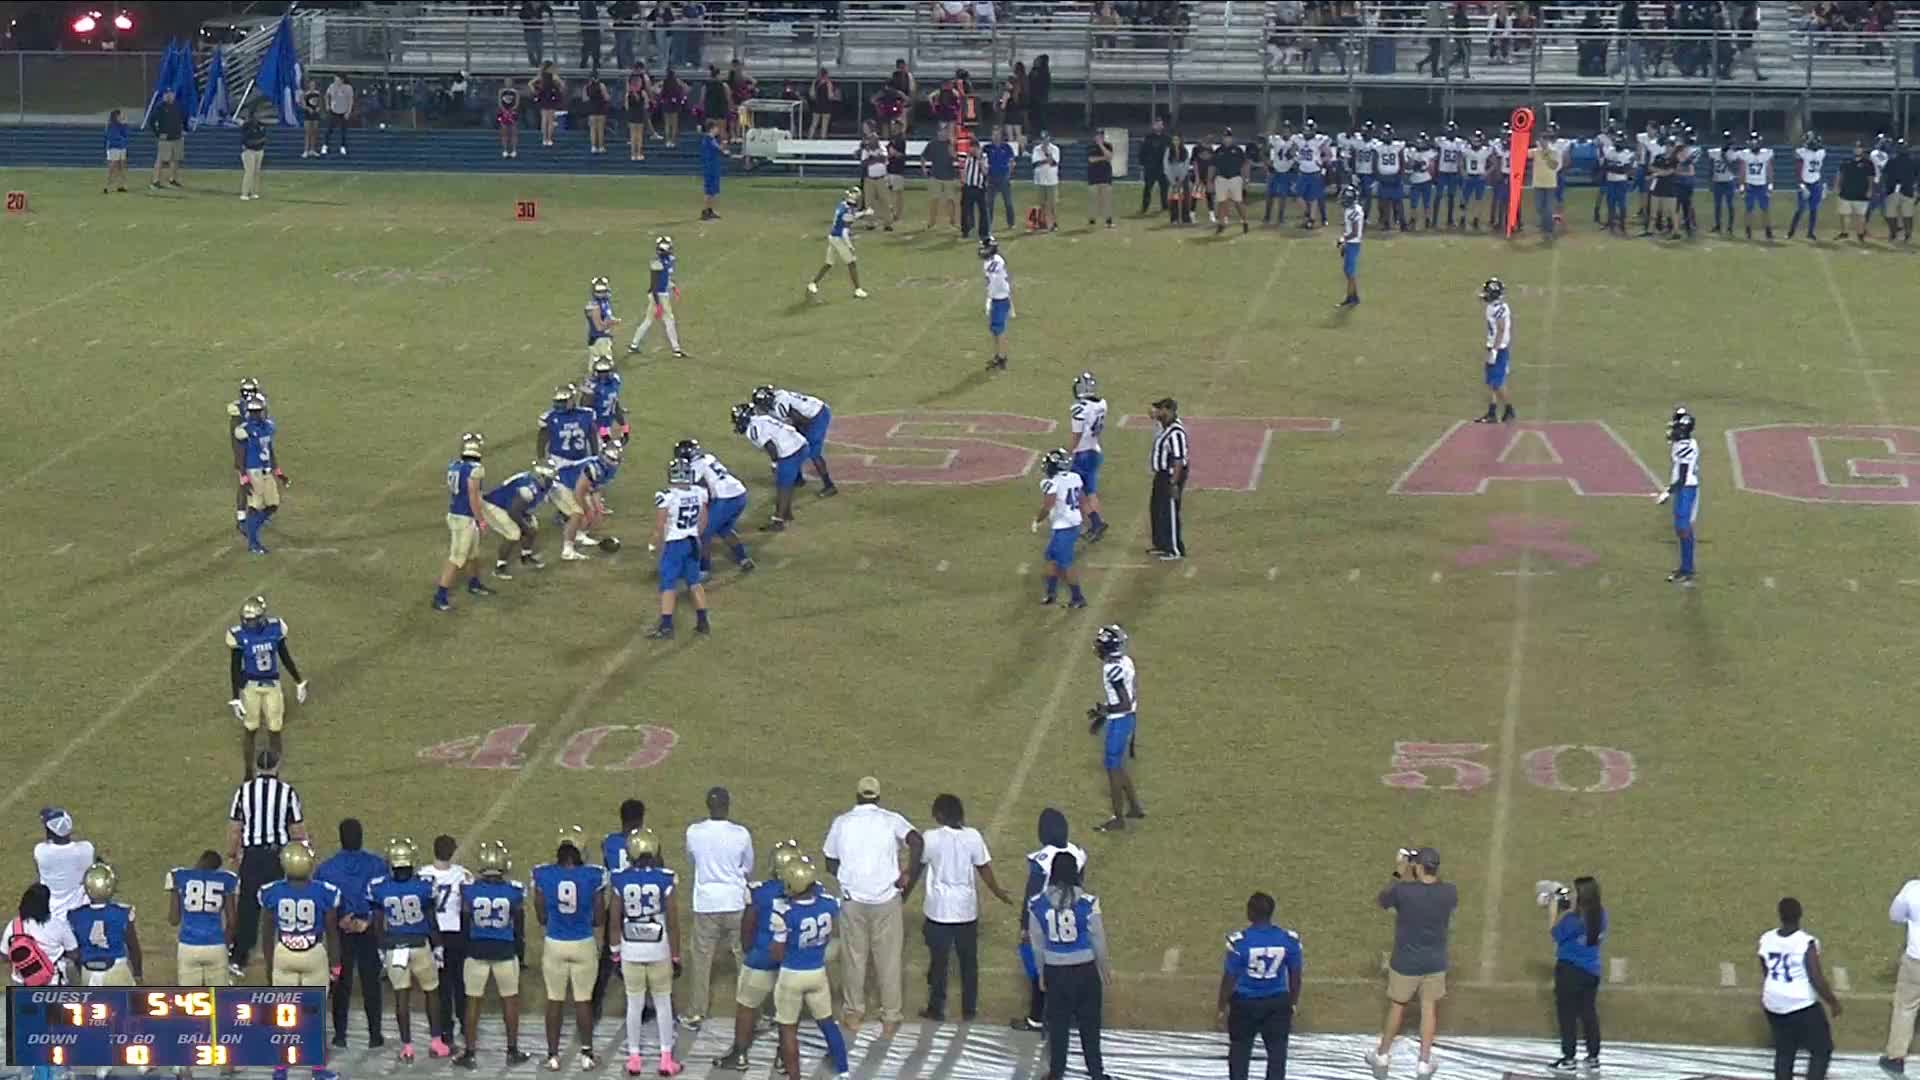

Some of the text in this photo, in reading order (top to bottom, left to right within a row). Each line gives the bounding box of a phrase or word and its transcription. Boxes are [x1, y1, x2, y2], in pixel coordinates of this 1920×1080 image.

[7, 192, 25, 210] 20
[517, 202, 535, 218] 30
[558, 429, 585, 450] 73
[676, 505, 700, 530] 52
[414, 723, 680, 770] 40
[1382, 741, 1637, 793] 50
[184, 879, 225, 913] 85
[383, 894, 424, 926] 38
[473, 896, 510, 928] 23
[557, 880, 578, 914] 9
[623, 884, 661, 917] 83
[278, 898, 315, 932] 99
[799, 912, 832, 949] 22
[1045, 909, 1078, 942] 18
[89, 920, 109, 949] 4
[1246, 946, 1286, 979] 57
